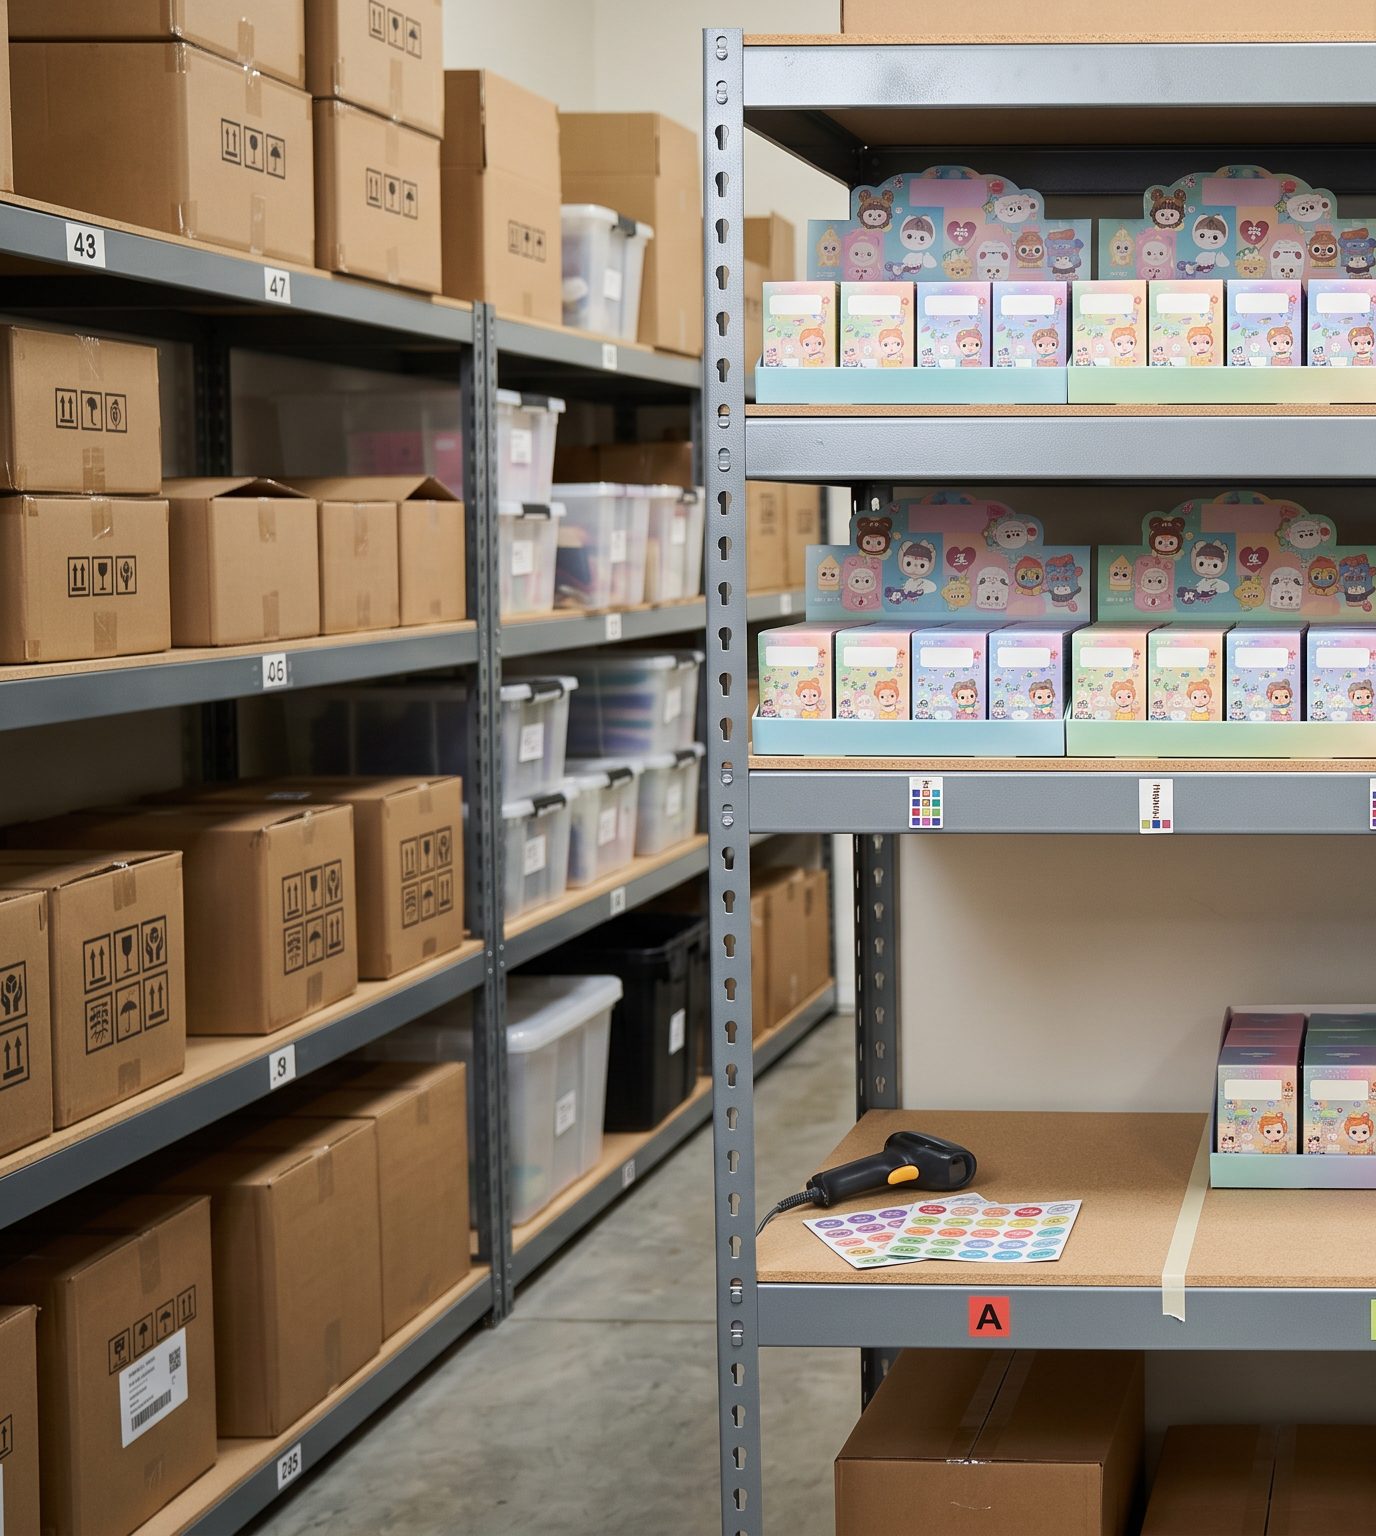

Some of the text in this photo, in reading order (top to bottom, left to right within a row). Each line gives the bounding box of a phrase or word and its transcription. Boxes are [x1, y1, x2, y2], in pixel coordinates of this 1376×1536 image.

[73, 232, 96, 259] 43
[269, 275, 286, 298] 47
[976, 1304, 1002, 1330] A
